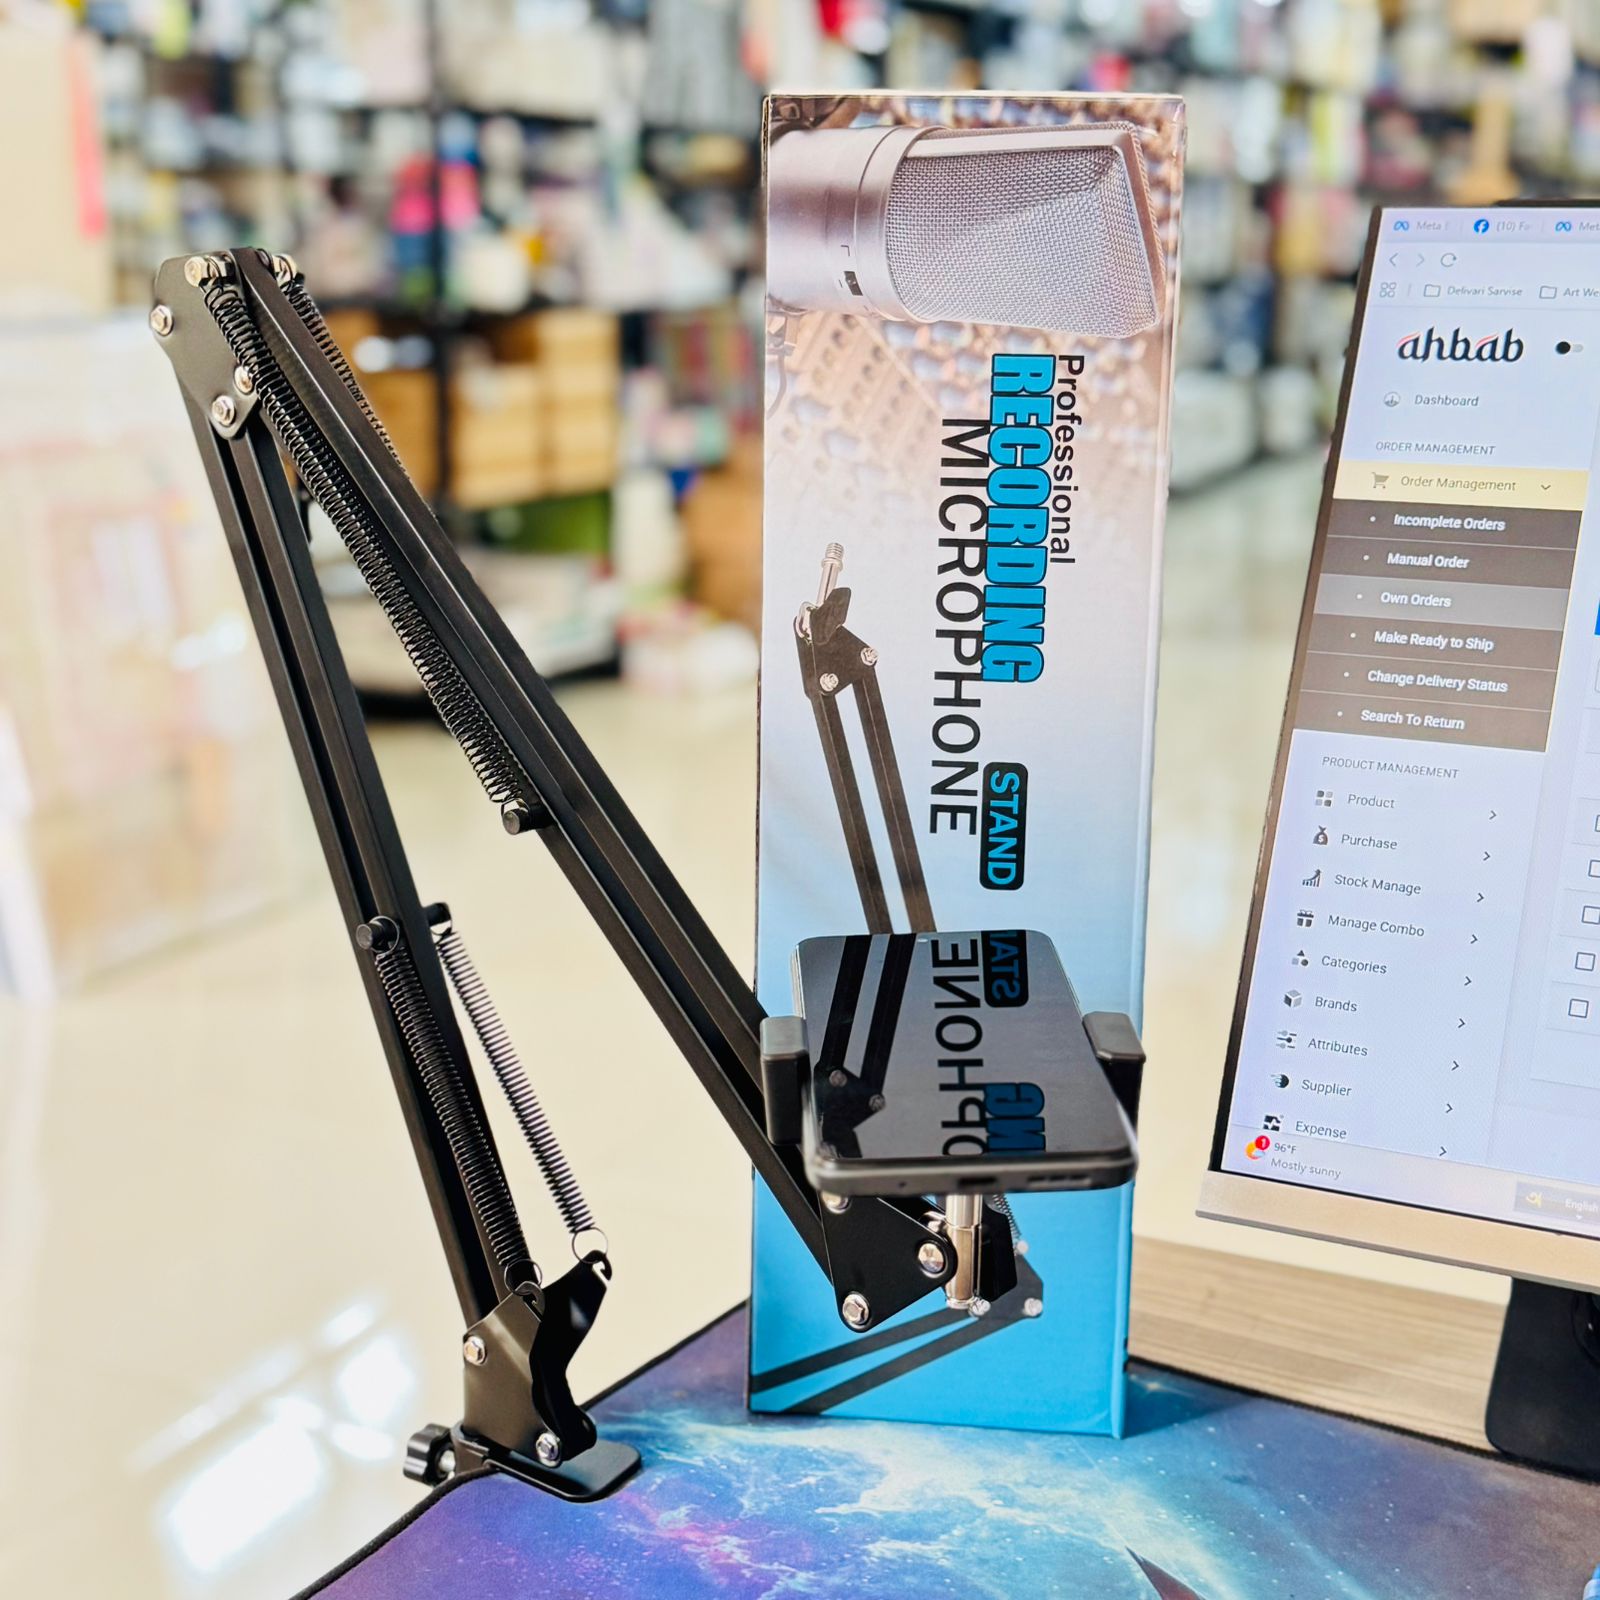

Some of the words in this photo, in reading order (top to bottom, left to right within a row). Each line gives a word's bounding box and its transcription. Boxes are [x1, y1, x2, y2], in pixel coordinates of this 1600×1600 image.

[1416, 221, 1442, 231] Meta
[1447, 286, 1485, 296] Delivari
[1487, 286, 1523, 297] Sarvise
[1563, 288, 1580, 297] Art
[1396, 326, 1524, 363] ahbab
[1414, 394, 1479, 407] Dashboard
[1375, 441, 1412, 452] ORDER
[1414, 443, 1496, 455] MANAGEMENT
[1050, 354, 1085, 564] Professional
[1401, 475, 1433, 488] Order
[1436, 478, 1516, 492] Management
[982, 353, 1056, 683] RECORDING
[1394, 514, 1461, 530] Incomplete
[1463, 517, 1506, 531] Orders
[1387, 552, 1432, 567] Manual
[1434, 555, 1470, 569] Order
[1380, 591, 1409, 605] Own
[1410, 594, 1452, 608] Orders
[930, 418, 991, 836] MICROPHONE
[1374, 630, 1408, 645] Make
[1410, 633, 1448, 650] Ready
[1450, 637, 1463, 649] to
[1465, 637, 1494, 653] Ship
[1368, 670, 1414, 687] Change
[1416, 675, 1465, 692] Delivery
[1467, 678, 1508, 692] Status
[1361, 709, 1403, 724] Search
[1405, 713, 1422, 726] To
[1423, 715, 1465, 730] Return
[1322, 756, 1375, 771] PRODUCT
[1376, 761, 1460, 779] MANAGEMENT
[1347, 794, 1395, 809] Product
[987, 769, 1021, 886] STAND
[1341, 834, 1398, 850] Purchase
[1334, 874, 1368, 889] Stock
[1371, 878, 1422, 896] Manage
[1328, 915, 1377, 932] Manage
[1380, 920, 1425, 937] Combo
[1321, 955, 1387, 975] Categories
[1315, 996, 1357, 1013] Brands
[1308, 1037, 1368, 1057] Attributes
[1302, 1079, 1352, 1097] Supplier
[1295, 1120, 1347, 1139] Expense
[1274, 1142, 1297, 1155] 96°F
[1270, 1158, 1307, 1175] Mostly
[1309, 1165, 1342, 1181] sunny
[1565, 1197, 1599, 1213] English
